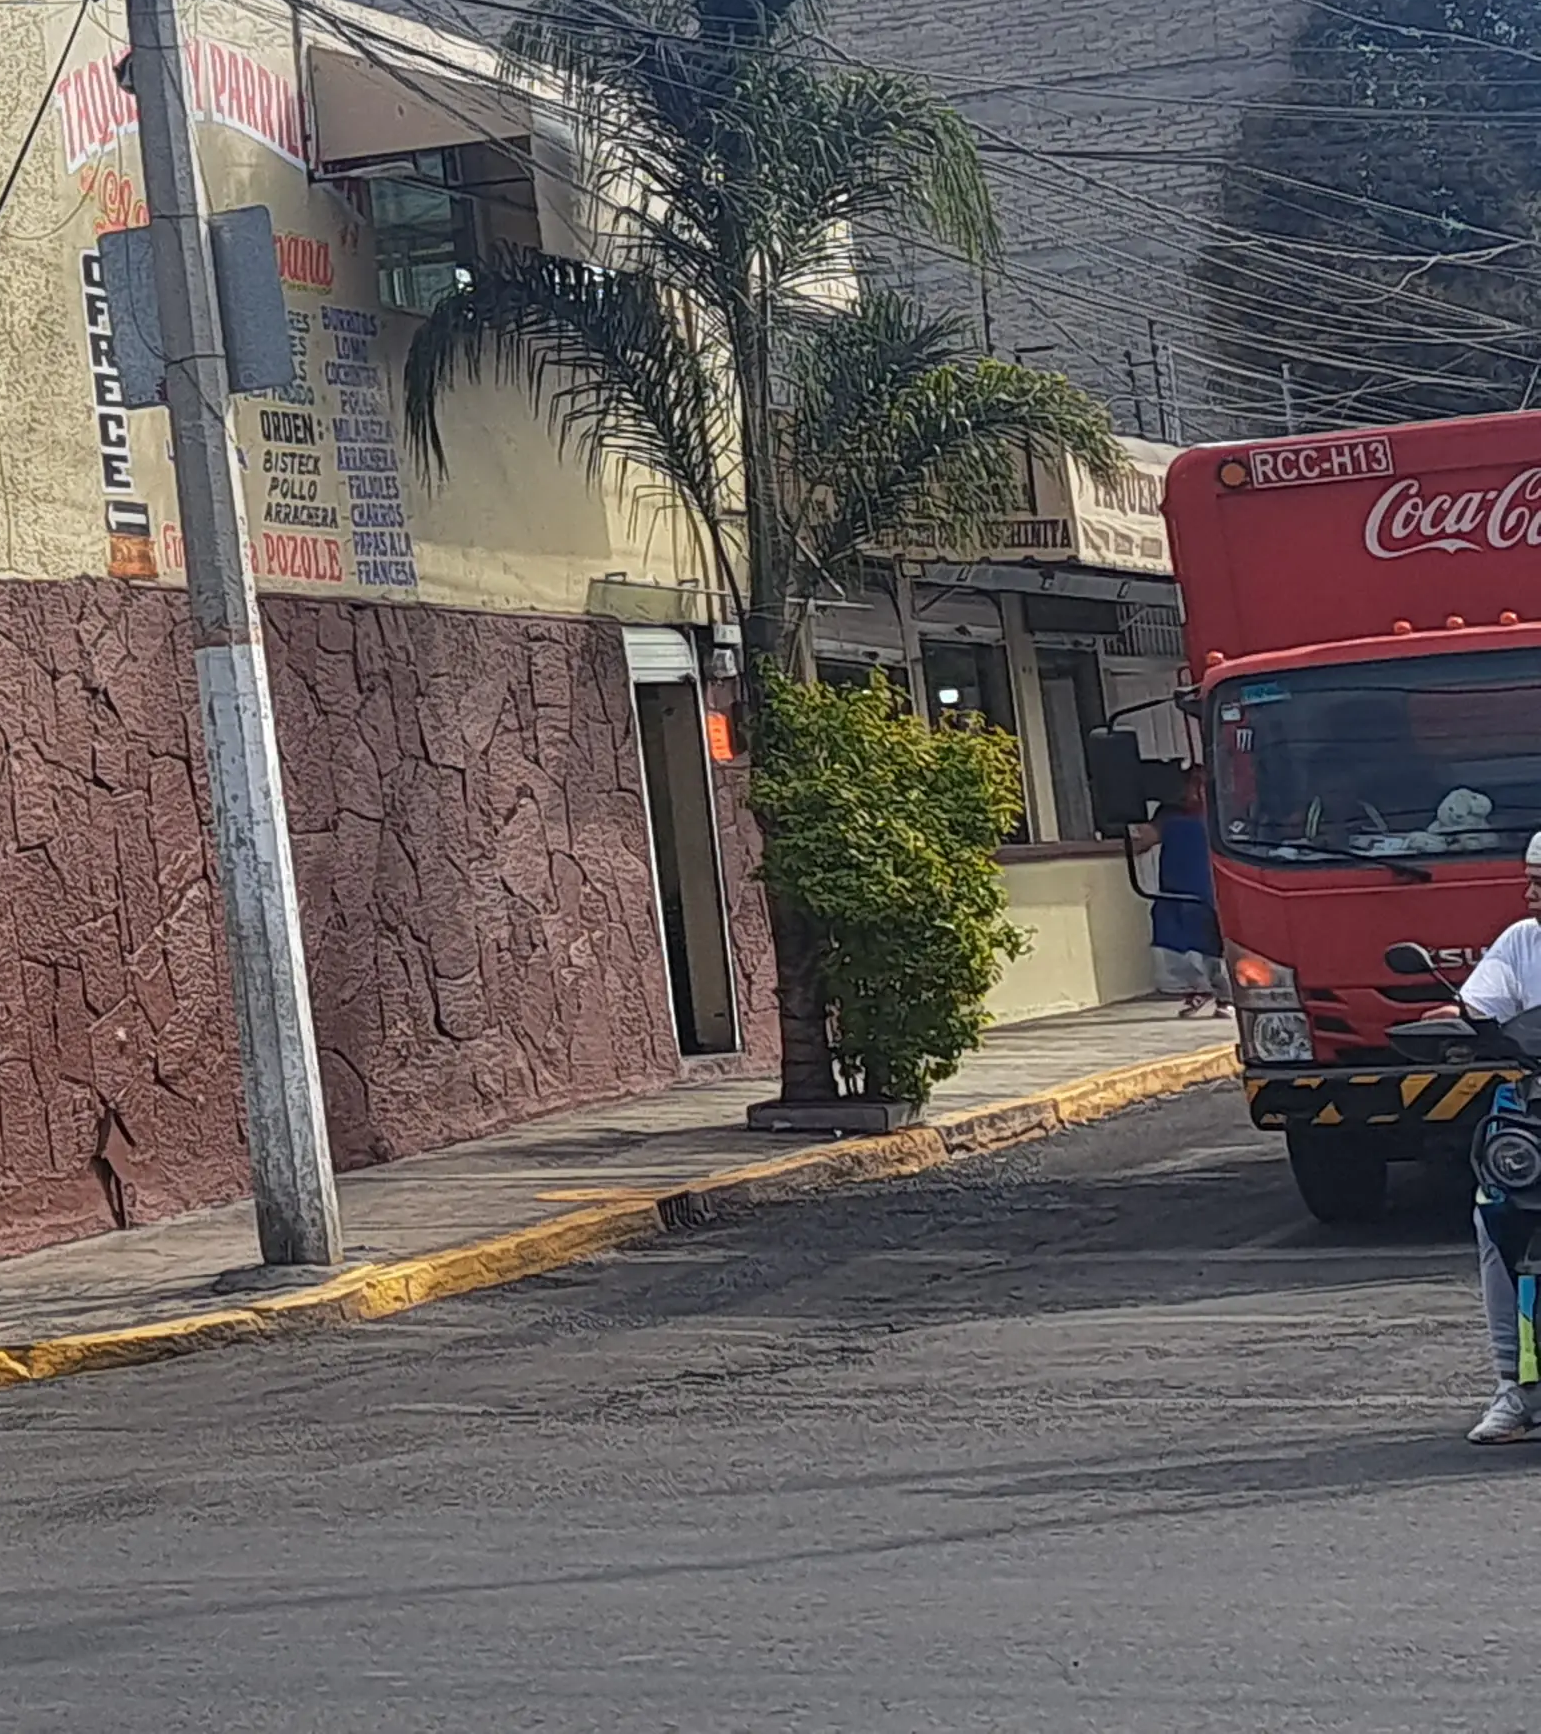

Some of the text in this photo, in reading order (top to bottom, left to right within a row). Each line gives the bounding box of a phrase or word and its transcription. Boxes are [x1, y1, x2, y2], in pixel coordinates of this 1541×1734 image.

[263, 450, 321, 476] BISTECK
[1255, 442, 1387, 483] RCC-H13
[268, 476, 317, 501] POLLO
[264, 504, 338, 529] ARRACHERA
[263, 533, 342, 582] POZOLE
